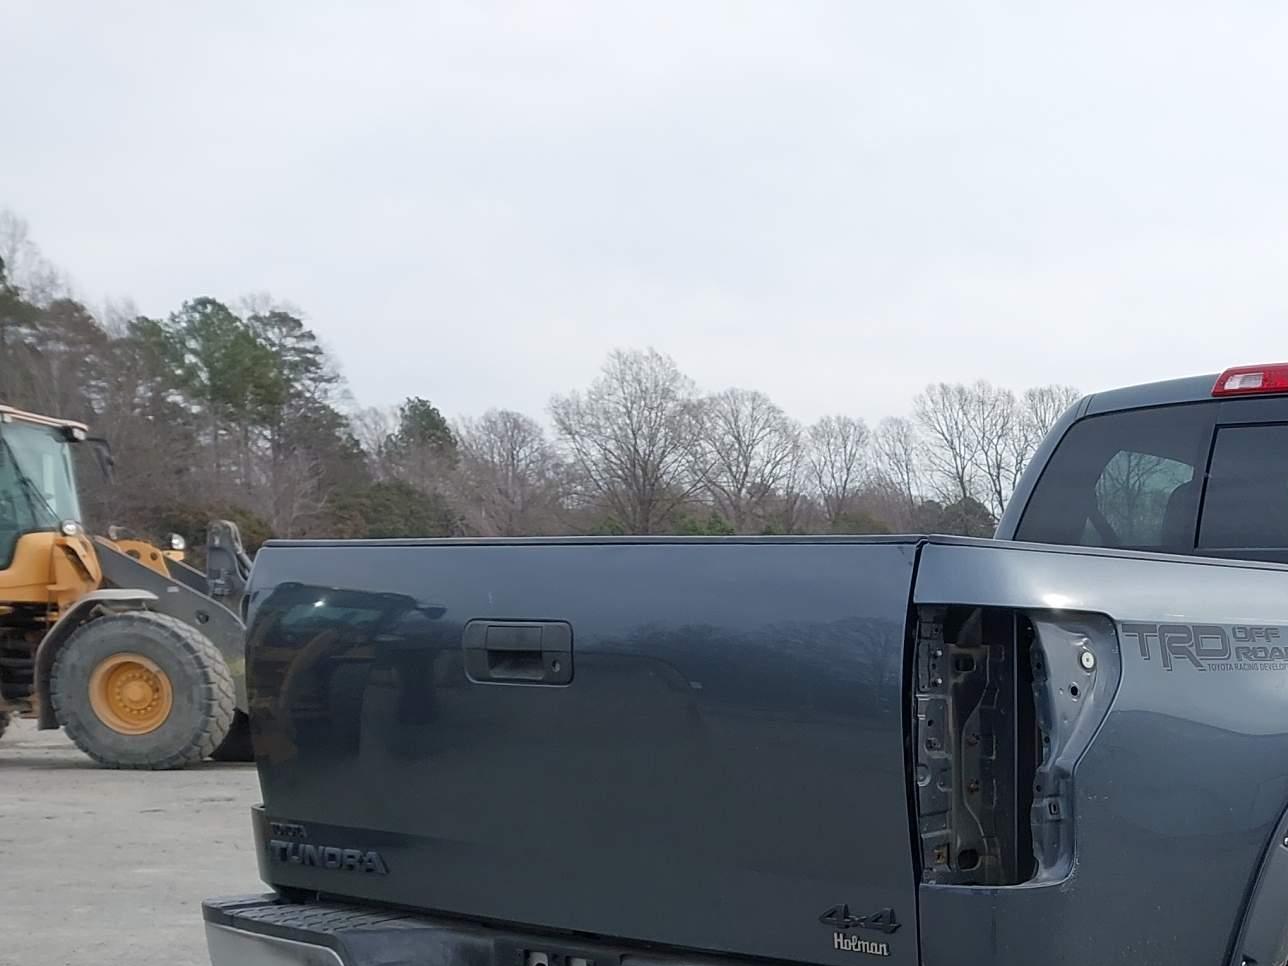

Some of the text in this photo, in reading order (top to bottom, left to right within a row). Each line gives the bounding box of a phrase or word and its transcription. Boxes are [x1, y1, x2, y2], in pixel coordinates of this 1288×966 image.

[1121, 623, 1281, 671] TRD OFF
[1207, 662, 1234, 672] TOYOTA
[1234, 662, 1259, 672] RACING
[270, 839, 389, 875] TUNDRA
[833, 932, 889, 956] Holman
